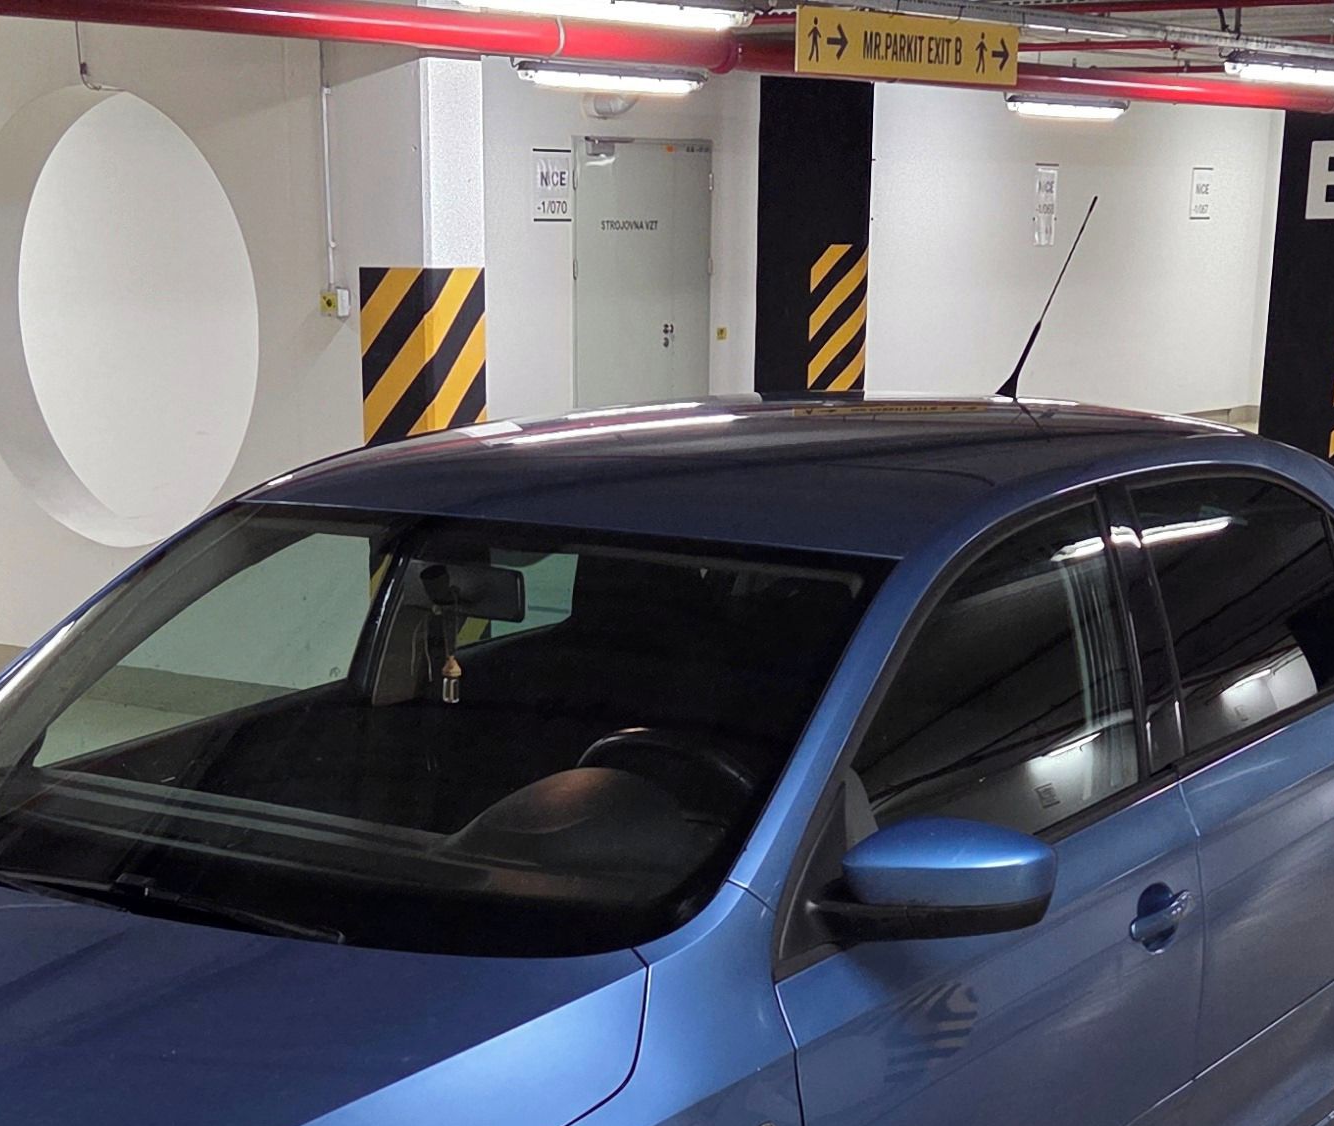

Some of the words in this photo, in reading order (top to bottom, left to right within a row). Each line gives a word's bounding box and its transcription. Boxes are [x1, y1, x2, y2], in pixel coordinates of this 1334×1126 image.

[862, 30, 924, 64] MR.PARKIT
[927, 36, 951, 65] EXIT
[954, 37, 963, 66] B
[537, 200, 568, 215] -1/070
[600, 220, 644, 231] STROJOVNA
